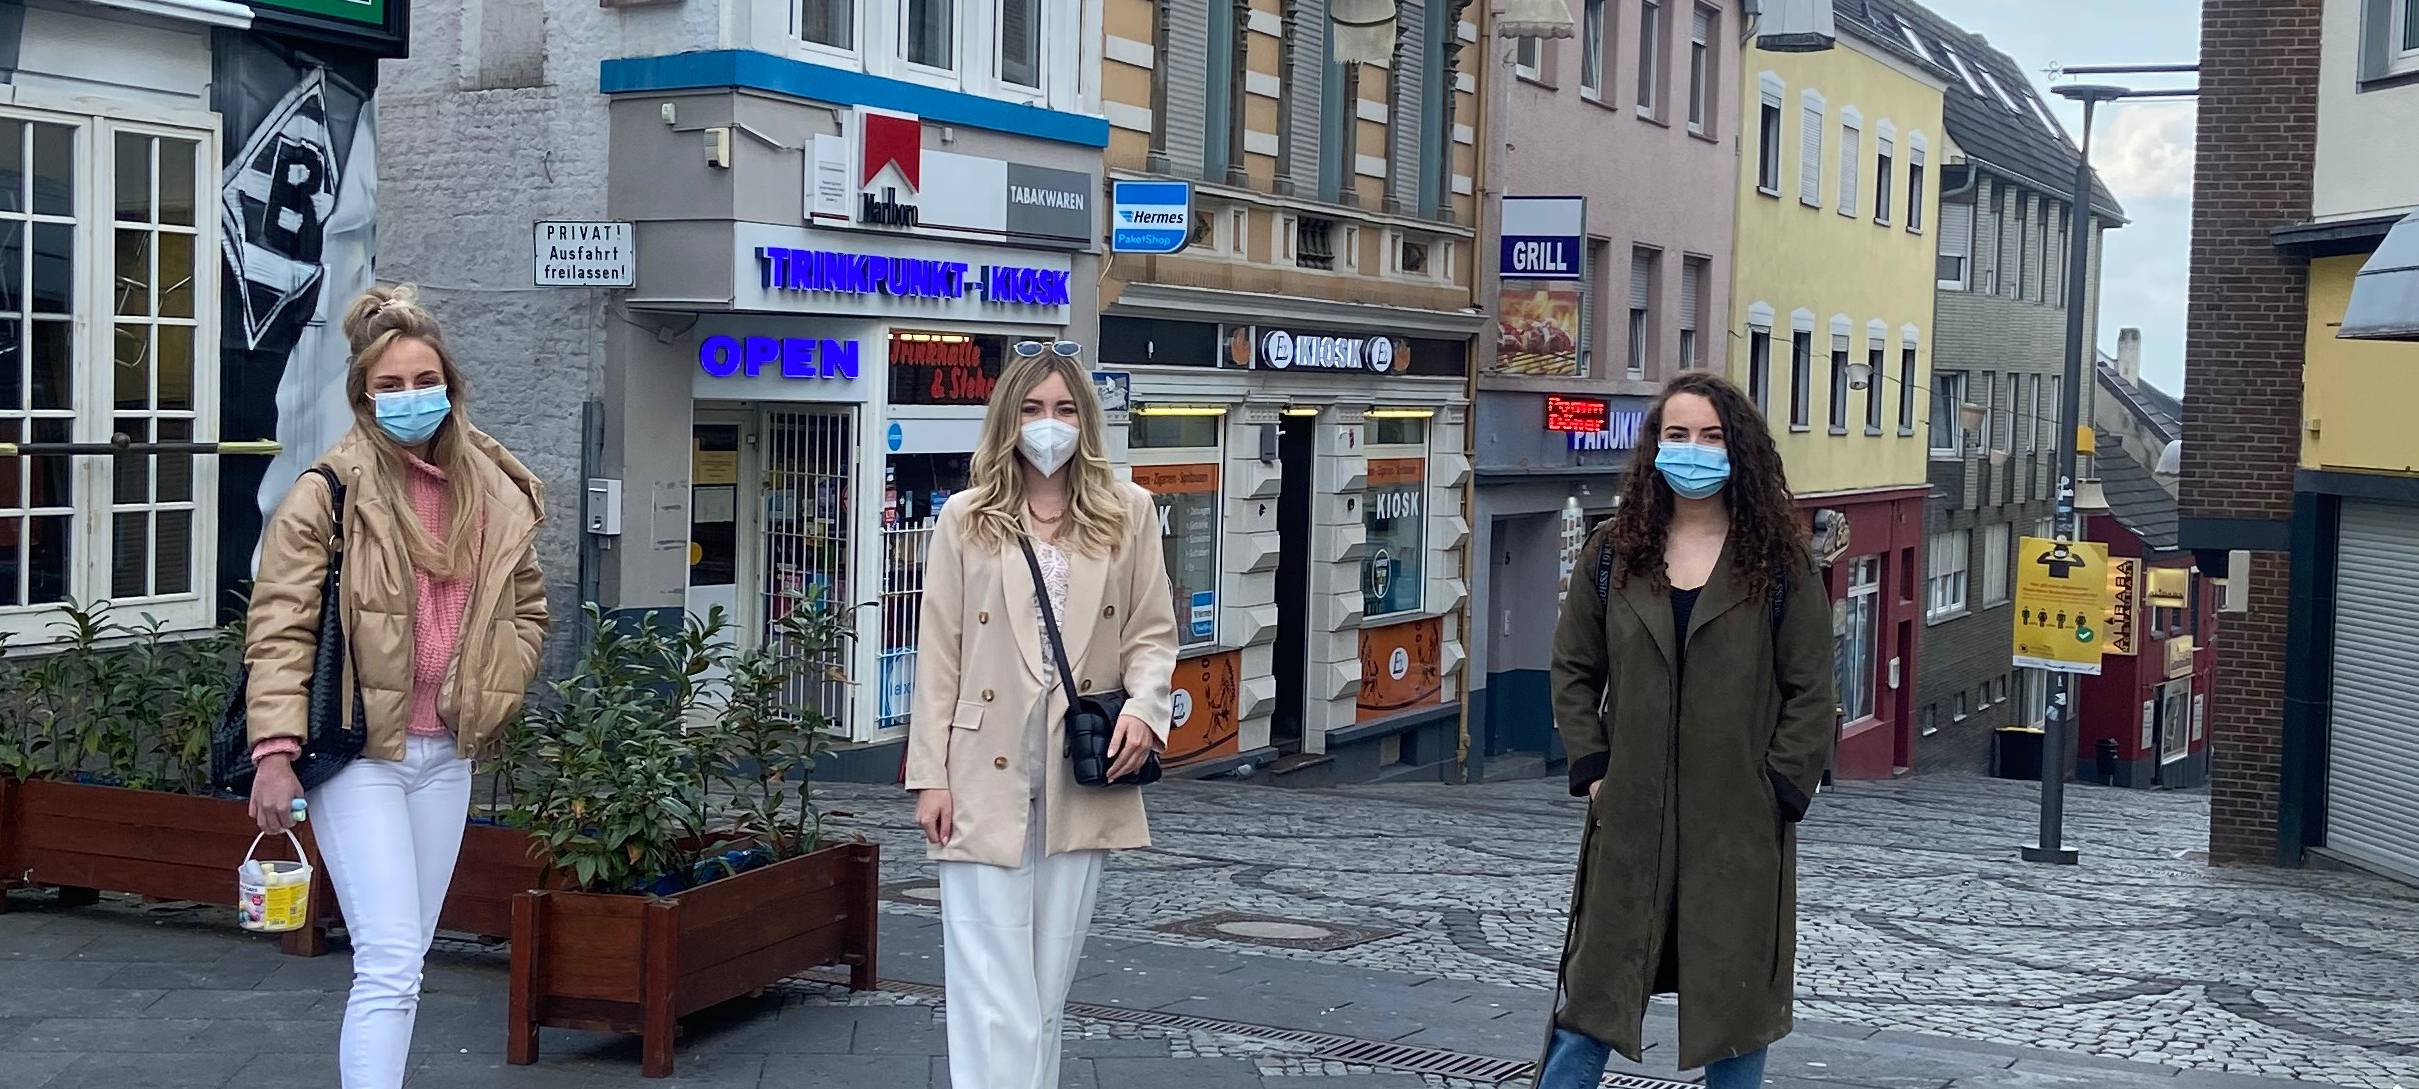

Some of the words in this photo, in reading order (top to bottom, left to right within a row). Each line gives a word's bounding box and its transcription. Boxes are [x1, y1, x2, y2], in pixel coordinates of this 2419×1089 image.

[863, 187, 919, 228] Marlboro
[1010, 186, 1084, 211] TABAKWAREN
[1134, 210, 1184, 225] Hermes
[547, 225, 621, 241] PRIVAT!
[1118, 233, 1171, 247] PaketShop
[549, 246, 619, 260] Ausfahrt
[1512, 241, 1567, 271] GRILL
[544, 265, 625, 279] freilassen!
[764, 246, 968, 299] TRINKPUNKT
[989, 264, 1070, 305] KIOSK
[699, 335, 859, 380] OPEN
[1296, 335, 1363, 369] KIOSK
[931, 367, 945, 399] &
[1376, 491, 1419, 520] KIOSK
